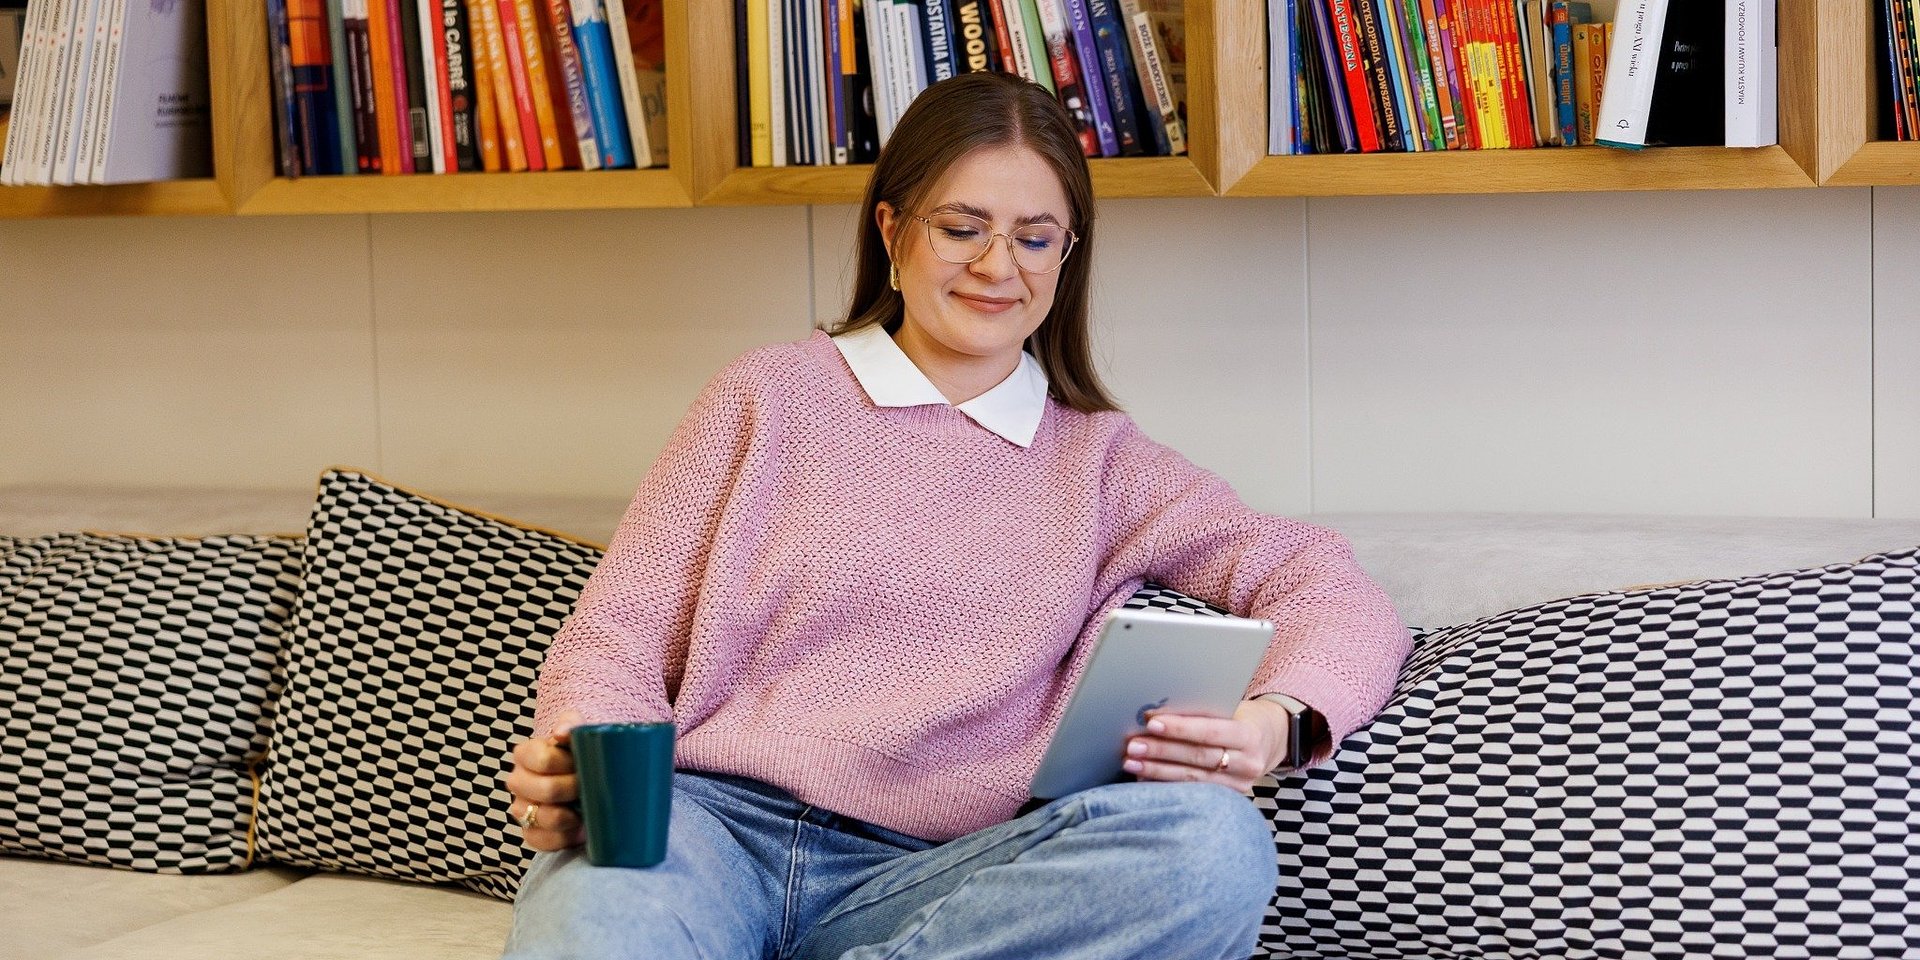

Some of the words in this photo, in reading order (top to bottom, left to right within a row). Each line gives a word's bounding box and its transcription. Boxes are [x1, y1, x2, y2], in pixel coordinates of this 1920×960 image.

[444, 9, 458, 27] le
[960, 1, 988, 73] WOOD
[1632, 37, 1643, 52] XXI
[446, 28, 468, 90] CARRÉ
[1360, 0, 1381, 64] CYKLOPEDIA
[1375, 67, 1397, 136] POWSZECHNA
[1559, 43, 1569, 76] Tuwim
[1628, 53, 1640, 77] wieku
[1561, 79, 1571, 105] Julian
